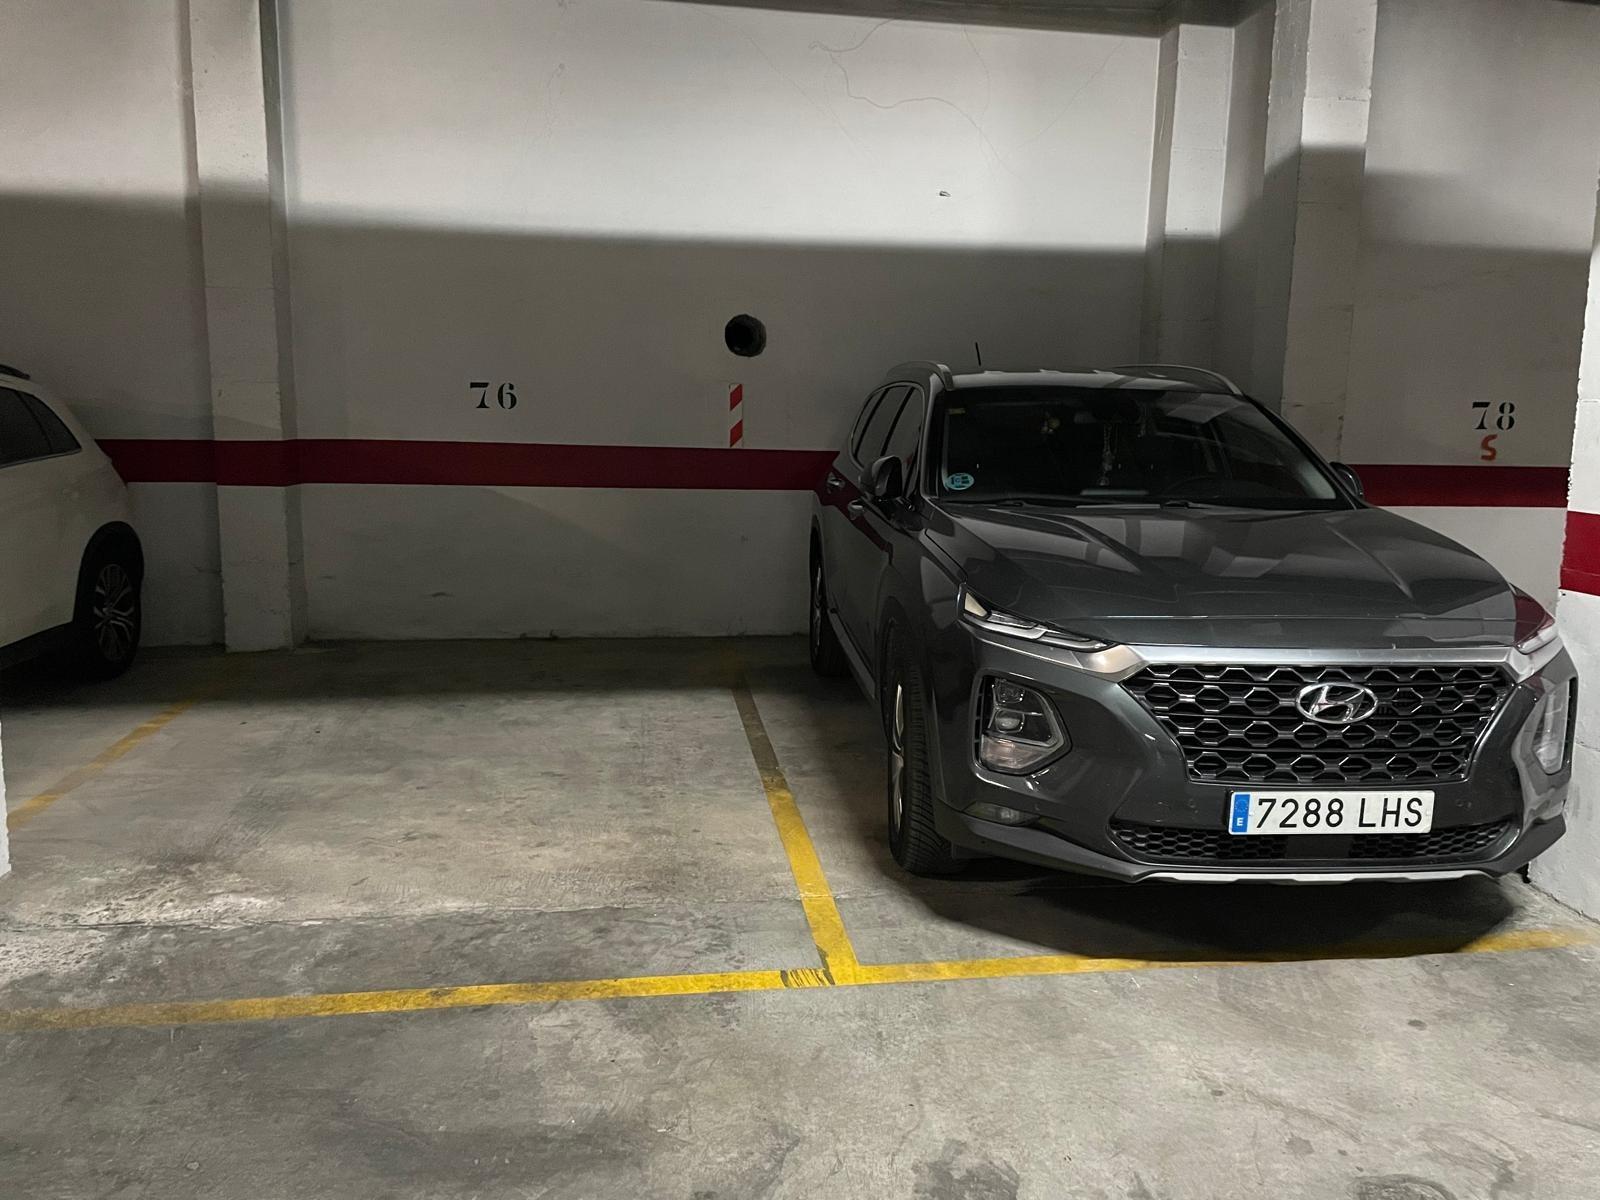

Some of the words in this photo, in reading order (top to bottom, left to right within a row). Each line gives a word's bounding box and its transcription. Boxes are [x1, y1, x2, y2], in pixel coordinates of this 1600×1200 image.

[469, 382, 518, 410] 76
[1471, 402, 1516, 431] 78
[1236, 817, 1244, 827] E
[1256, 798, 1345, 828] 7288
[1358, 797, 1424, 828] LHS
